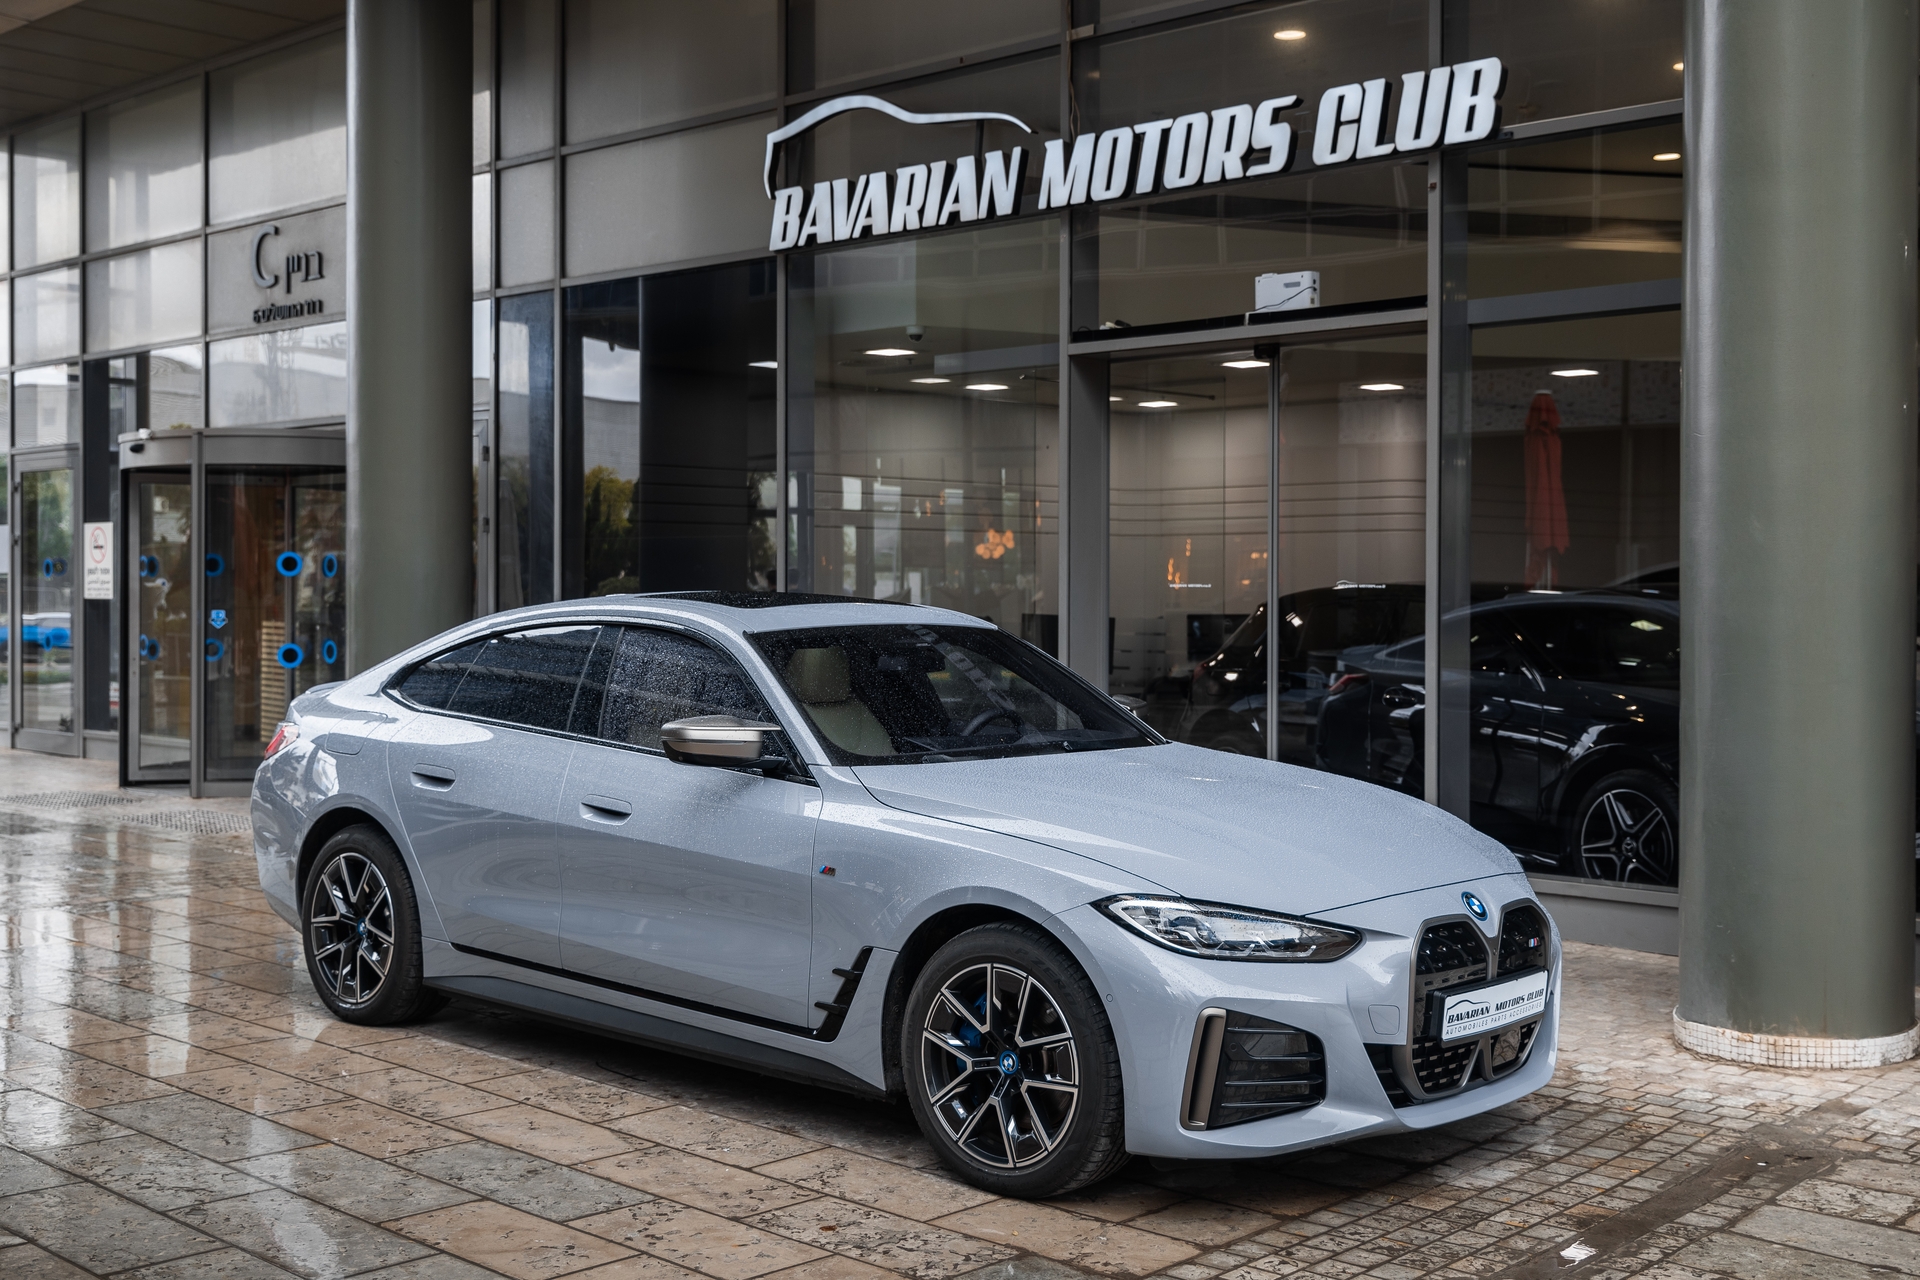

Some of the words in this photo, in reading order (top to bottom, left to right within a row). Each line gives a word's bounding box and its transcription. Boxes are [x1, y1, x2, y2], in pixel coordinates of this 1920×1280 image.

[769, 146, 1025, 251] BAVARIAN
[1038, 95, 1299, 210] MOTORS
[1312, 57, 1503, 166] CLUB
[252, 224, 279, 289] C
[1445, 1018, 1488, 1036] AUTOMOBILES
[1491, 1013, 1507, 1024] PARTS
[1509, 1001, 1542, 1018] ACCESSORIES
[1447, 1005, 1491, 1024] BAVARIAN
[1495, 994, 1526, 1012] MOTORS
[1526, 988, 1545, 1002] CLUB
